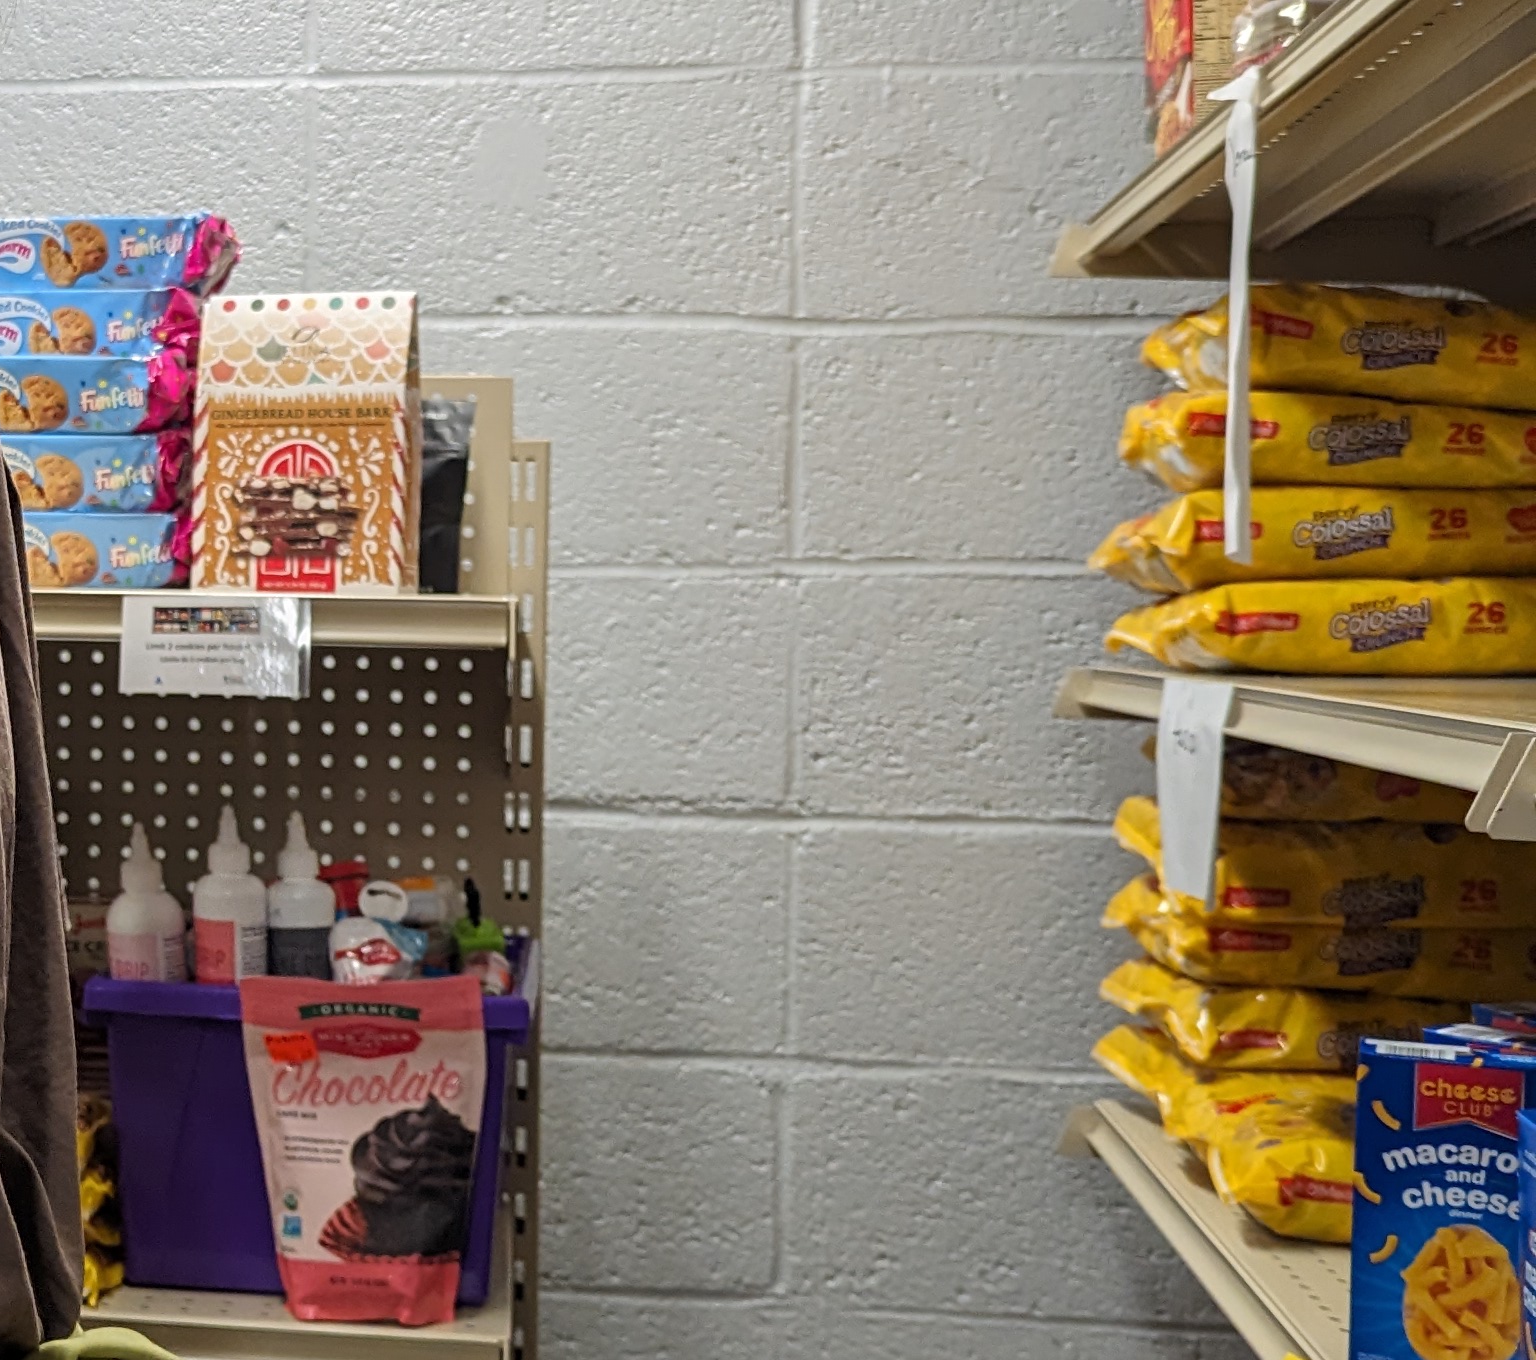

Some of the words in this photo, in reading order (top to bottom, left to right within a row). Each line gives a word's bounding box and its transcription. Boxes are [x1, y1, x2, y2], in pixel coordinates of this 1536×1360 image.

[26, 218, 63, 241] Cookies
[120, 232, 184, 259] Funfetti
[14, 300, 49, 322] Cookies
[1341, 326, 1446, 355] Colossal
[1481, 331, 1519, 355] 26
[79, 387, 146, 413] Funfetti
[211, 408, 304, 421] GINGERBREAD
[307, 407, 351, 419] HOUSE
[356, 406, 390, 419] BARK
[1308, 416, 1412, 451] Colossal
[1446, 423, 1486, 450] 26
[1292, 504, 1395, 549] Colossal
[1430, 507, 1468, 532] 26
[1328, 597, 1432, 641] Colossal
[1467, 601, 1507, 625] 26
[320, 1004, 399, 1017] ORGANIC
[271, 1057, 463, 1108] Chocolate
[1419, 1077, 1516, 1104] cheese
[1444, 1168, 1487, 1186] and
